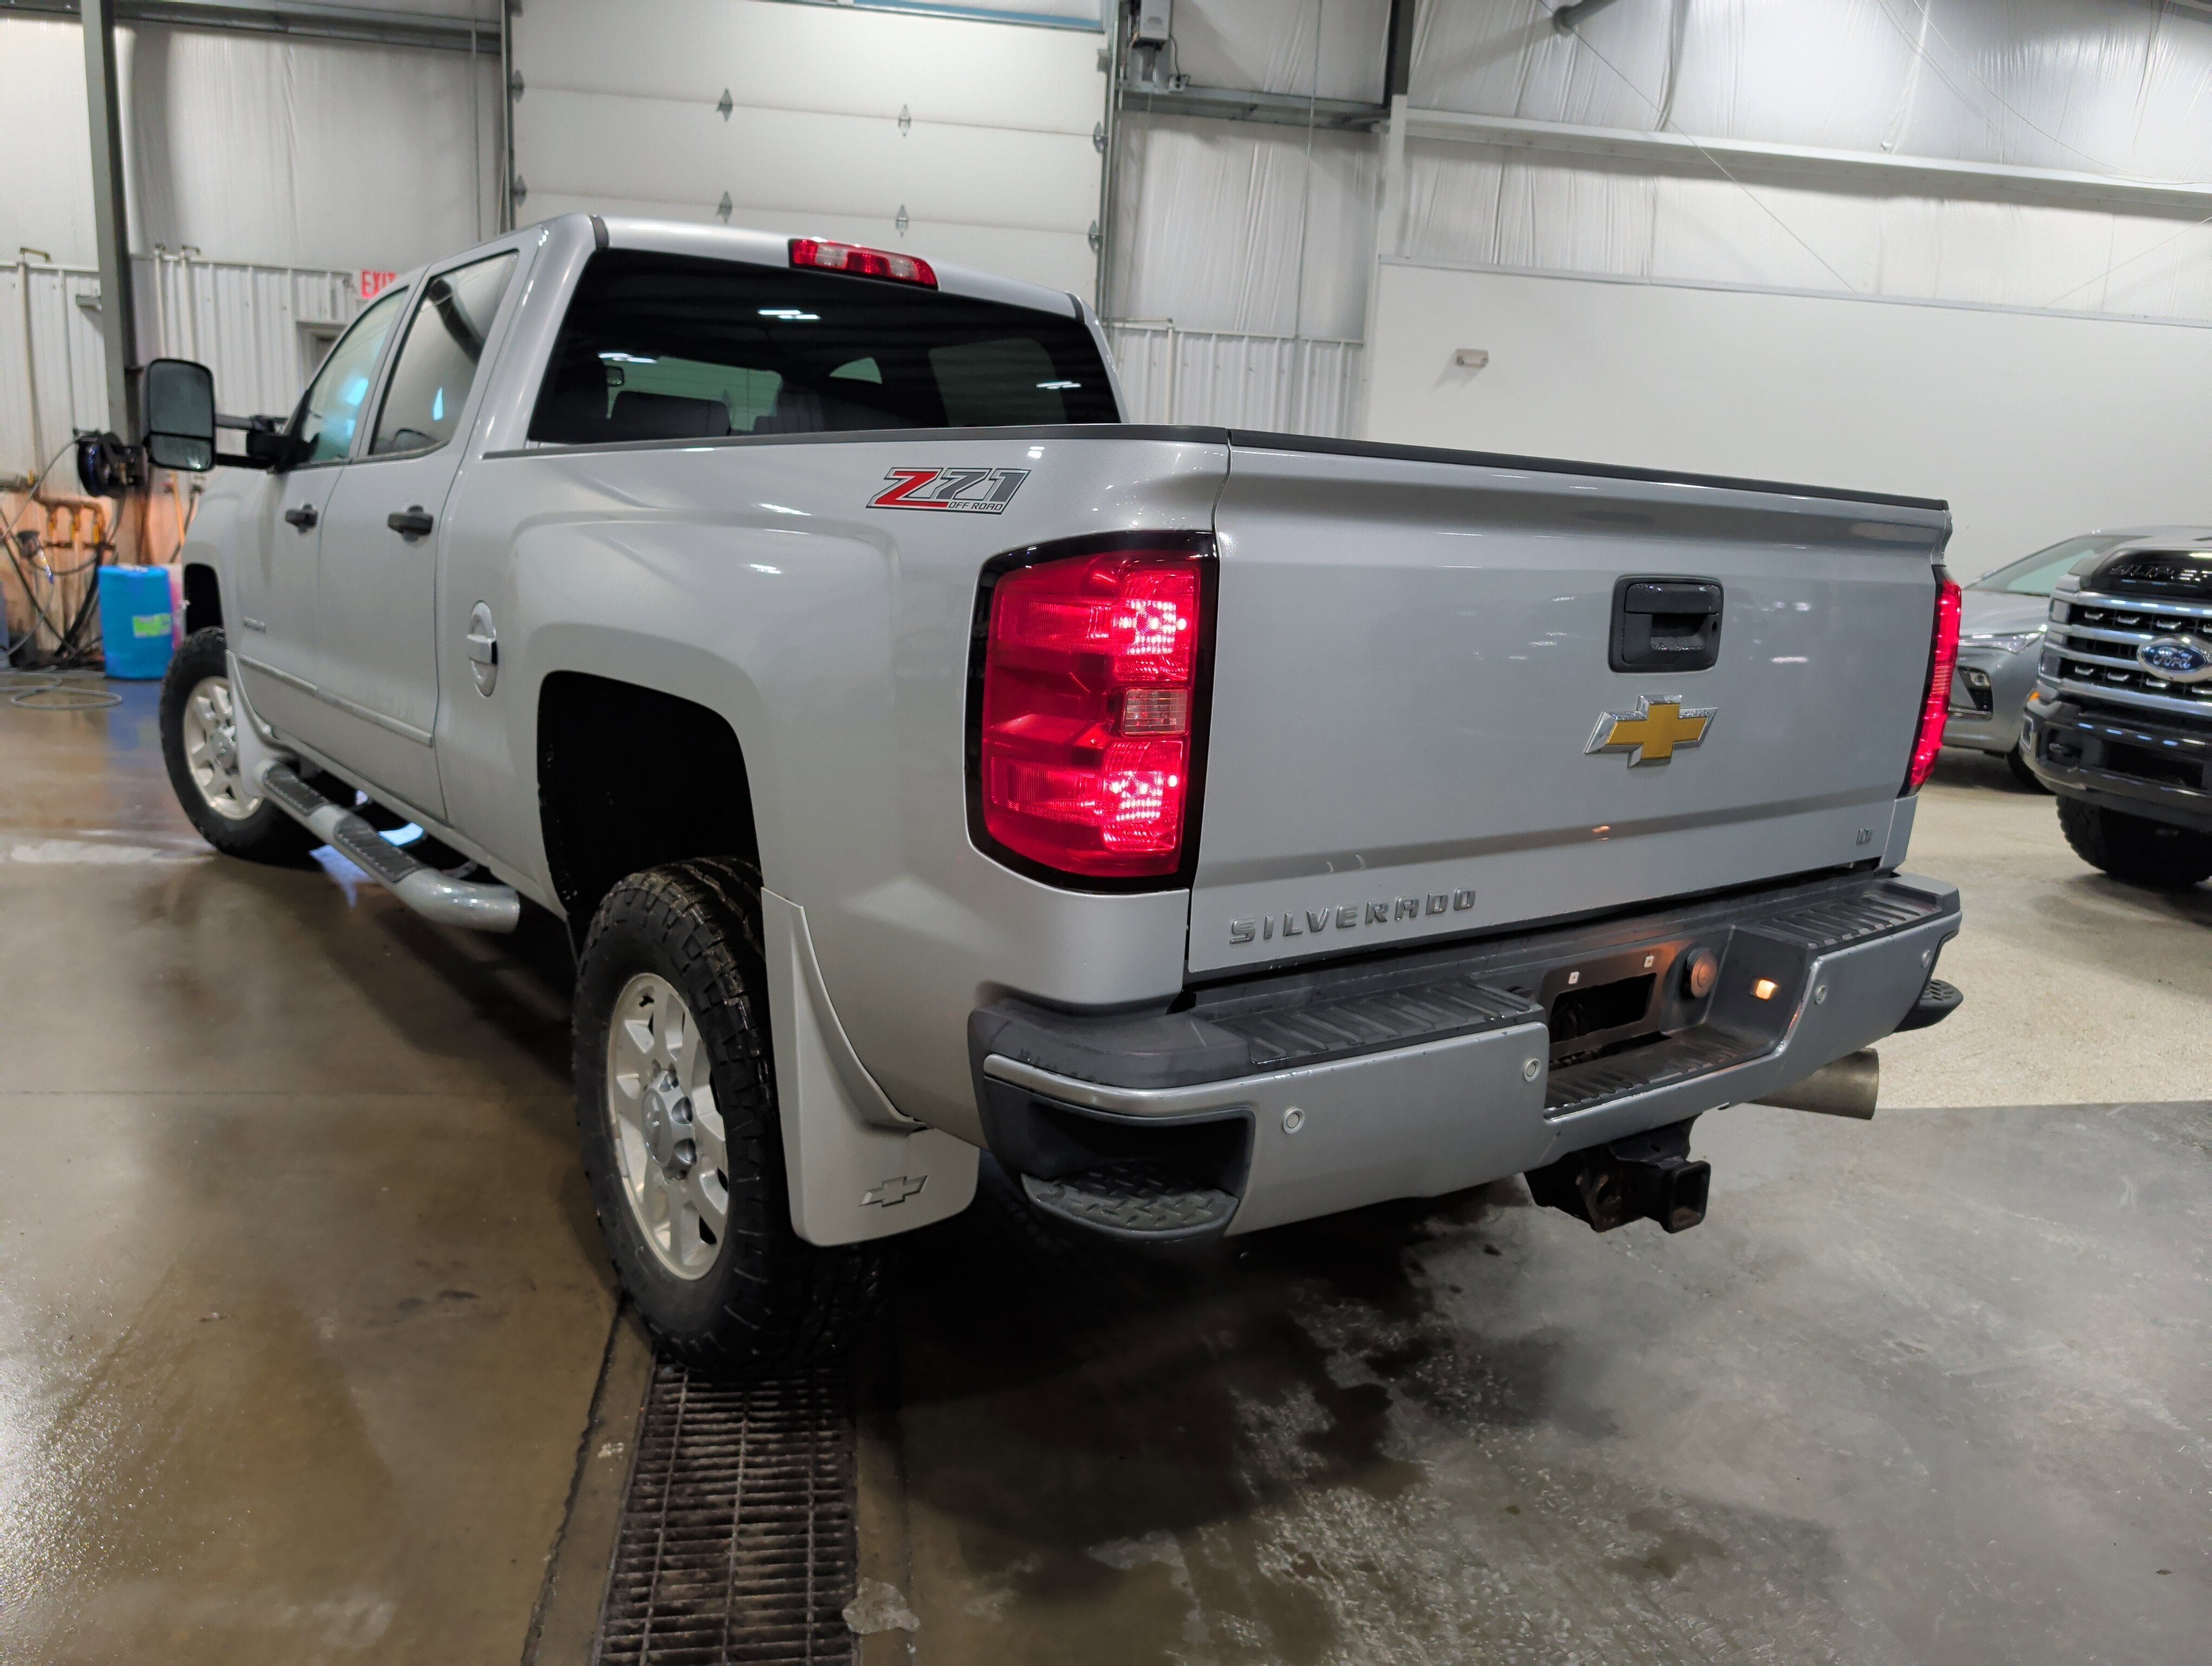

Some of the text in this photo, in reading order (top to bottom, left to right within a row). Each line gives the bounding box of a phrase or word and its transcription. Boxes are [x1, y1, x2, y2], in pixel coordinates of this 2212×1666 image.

[866, 467, 1031, 513] Z71
[972, 502, 1004, 511] ROAD
[2153, 646, 2192, 669] Ford
[1229, 888, 1476, 944] SILVERADO
